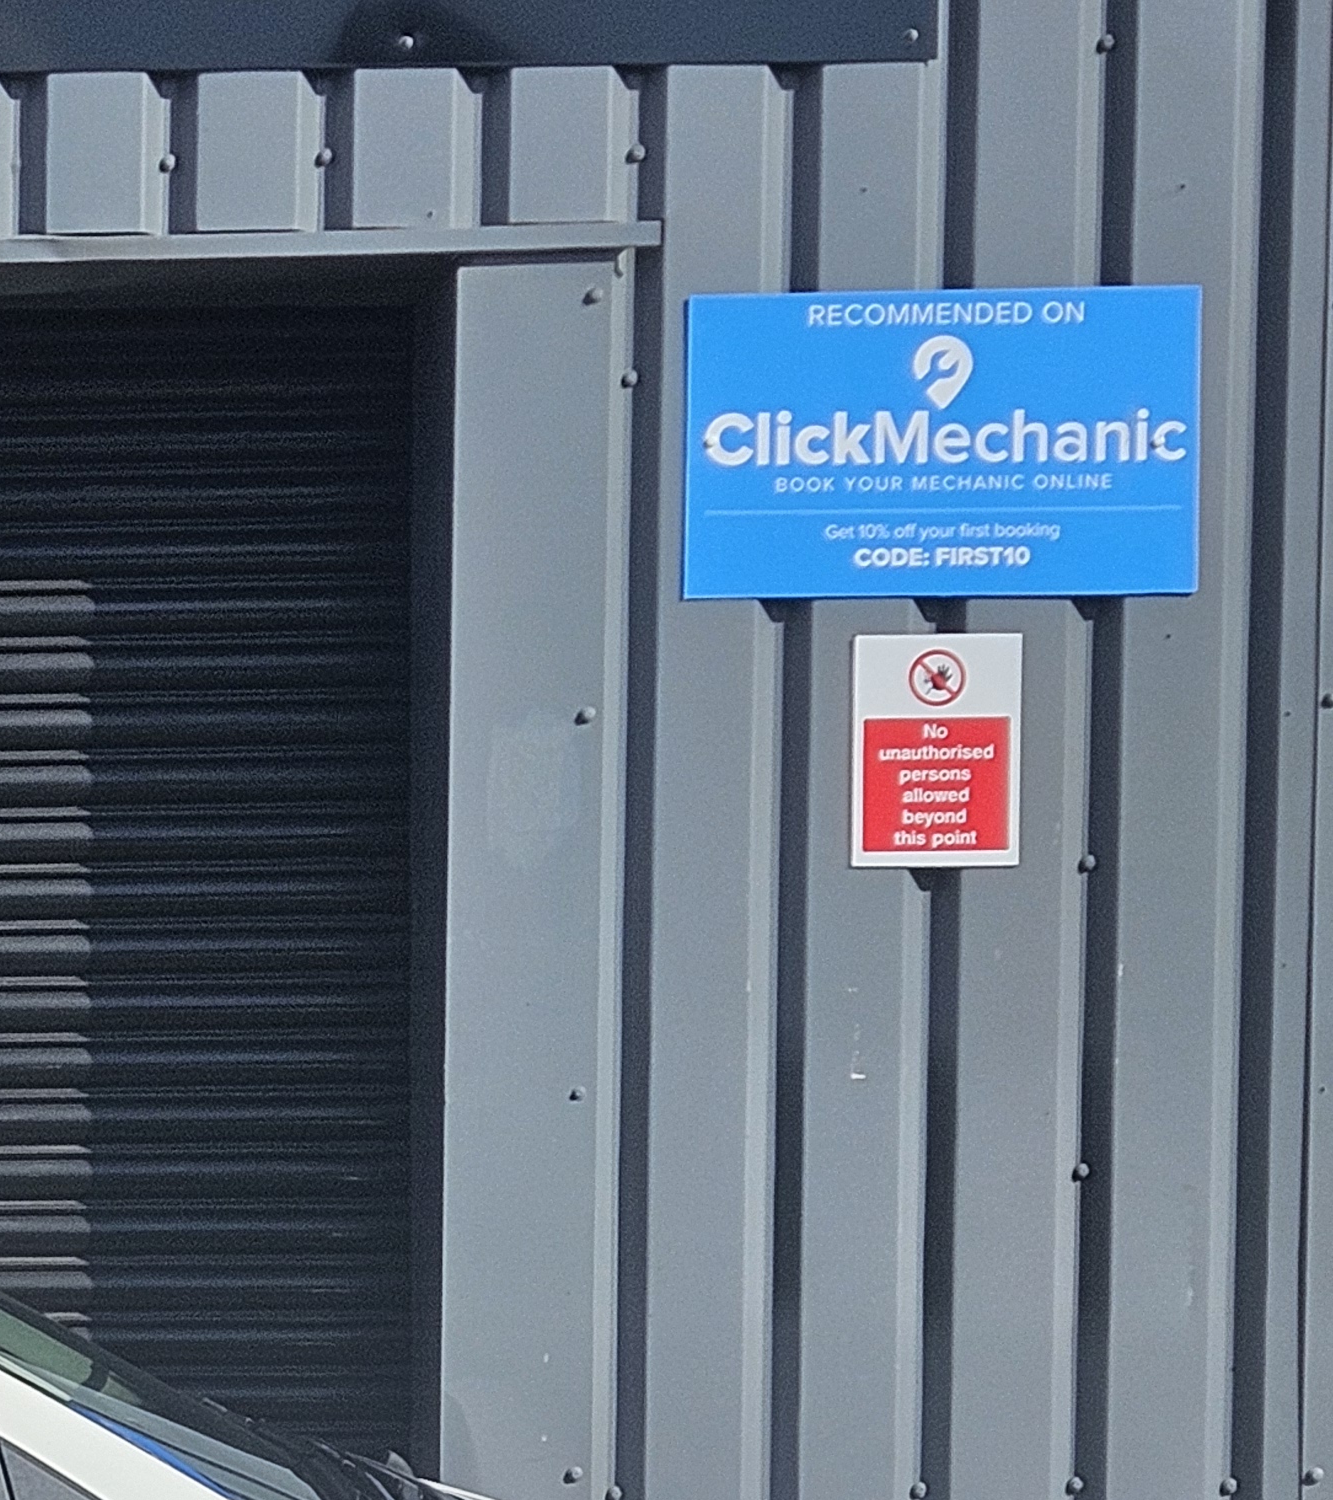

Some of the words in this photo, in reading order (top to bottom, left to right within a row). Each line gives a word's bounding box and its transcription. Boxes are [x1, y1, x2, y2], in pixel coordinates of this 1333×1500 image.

[807, 303, 1033, 327] RECOMMENDED
[1042, 301, 1085, 324] ON
[705, 408, 1187, 466] ClickMechanic
[774, 476, 835, 493] BOOK
[844, 475, 903, 492] YOUR
[911, 474, 1025, 491] MECHANIC
[1034, 473, 1113, 490] ONLINE
[825, 524, 855, 540] Get
[858, 523, 889, 539] 10%
[893, 522, 916, 539] off
[918, 526, 955, 542] your
[958, 522, 992, 538] first
[994, 522, 1061, 542] booking
[853, 548, 930, 567] CODE:
[936, 547, 1031, 566] FIRST10
[922, 724, 948, 739] No
[879, 744, 995, 761] unauthorised
[899, 768, 972, 785] persons
[902, 787, 970, 803] allowed
[902, 809, 968, 828] beyond
[894, 830, 926, 846] this
[932, 830, 977, 848] point
